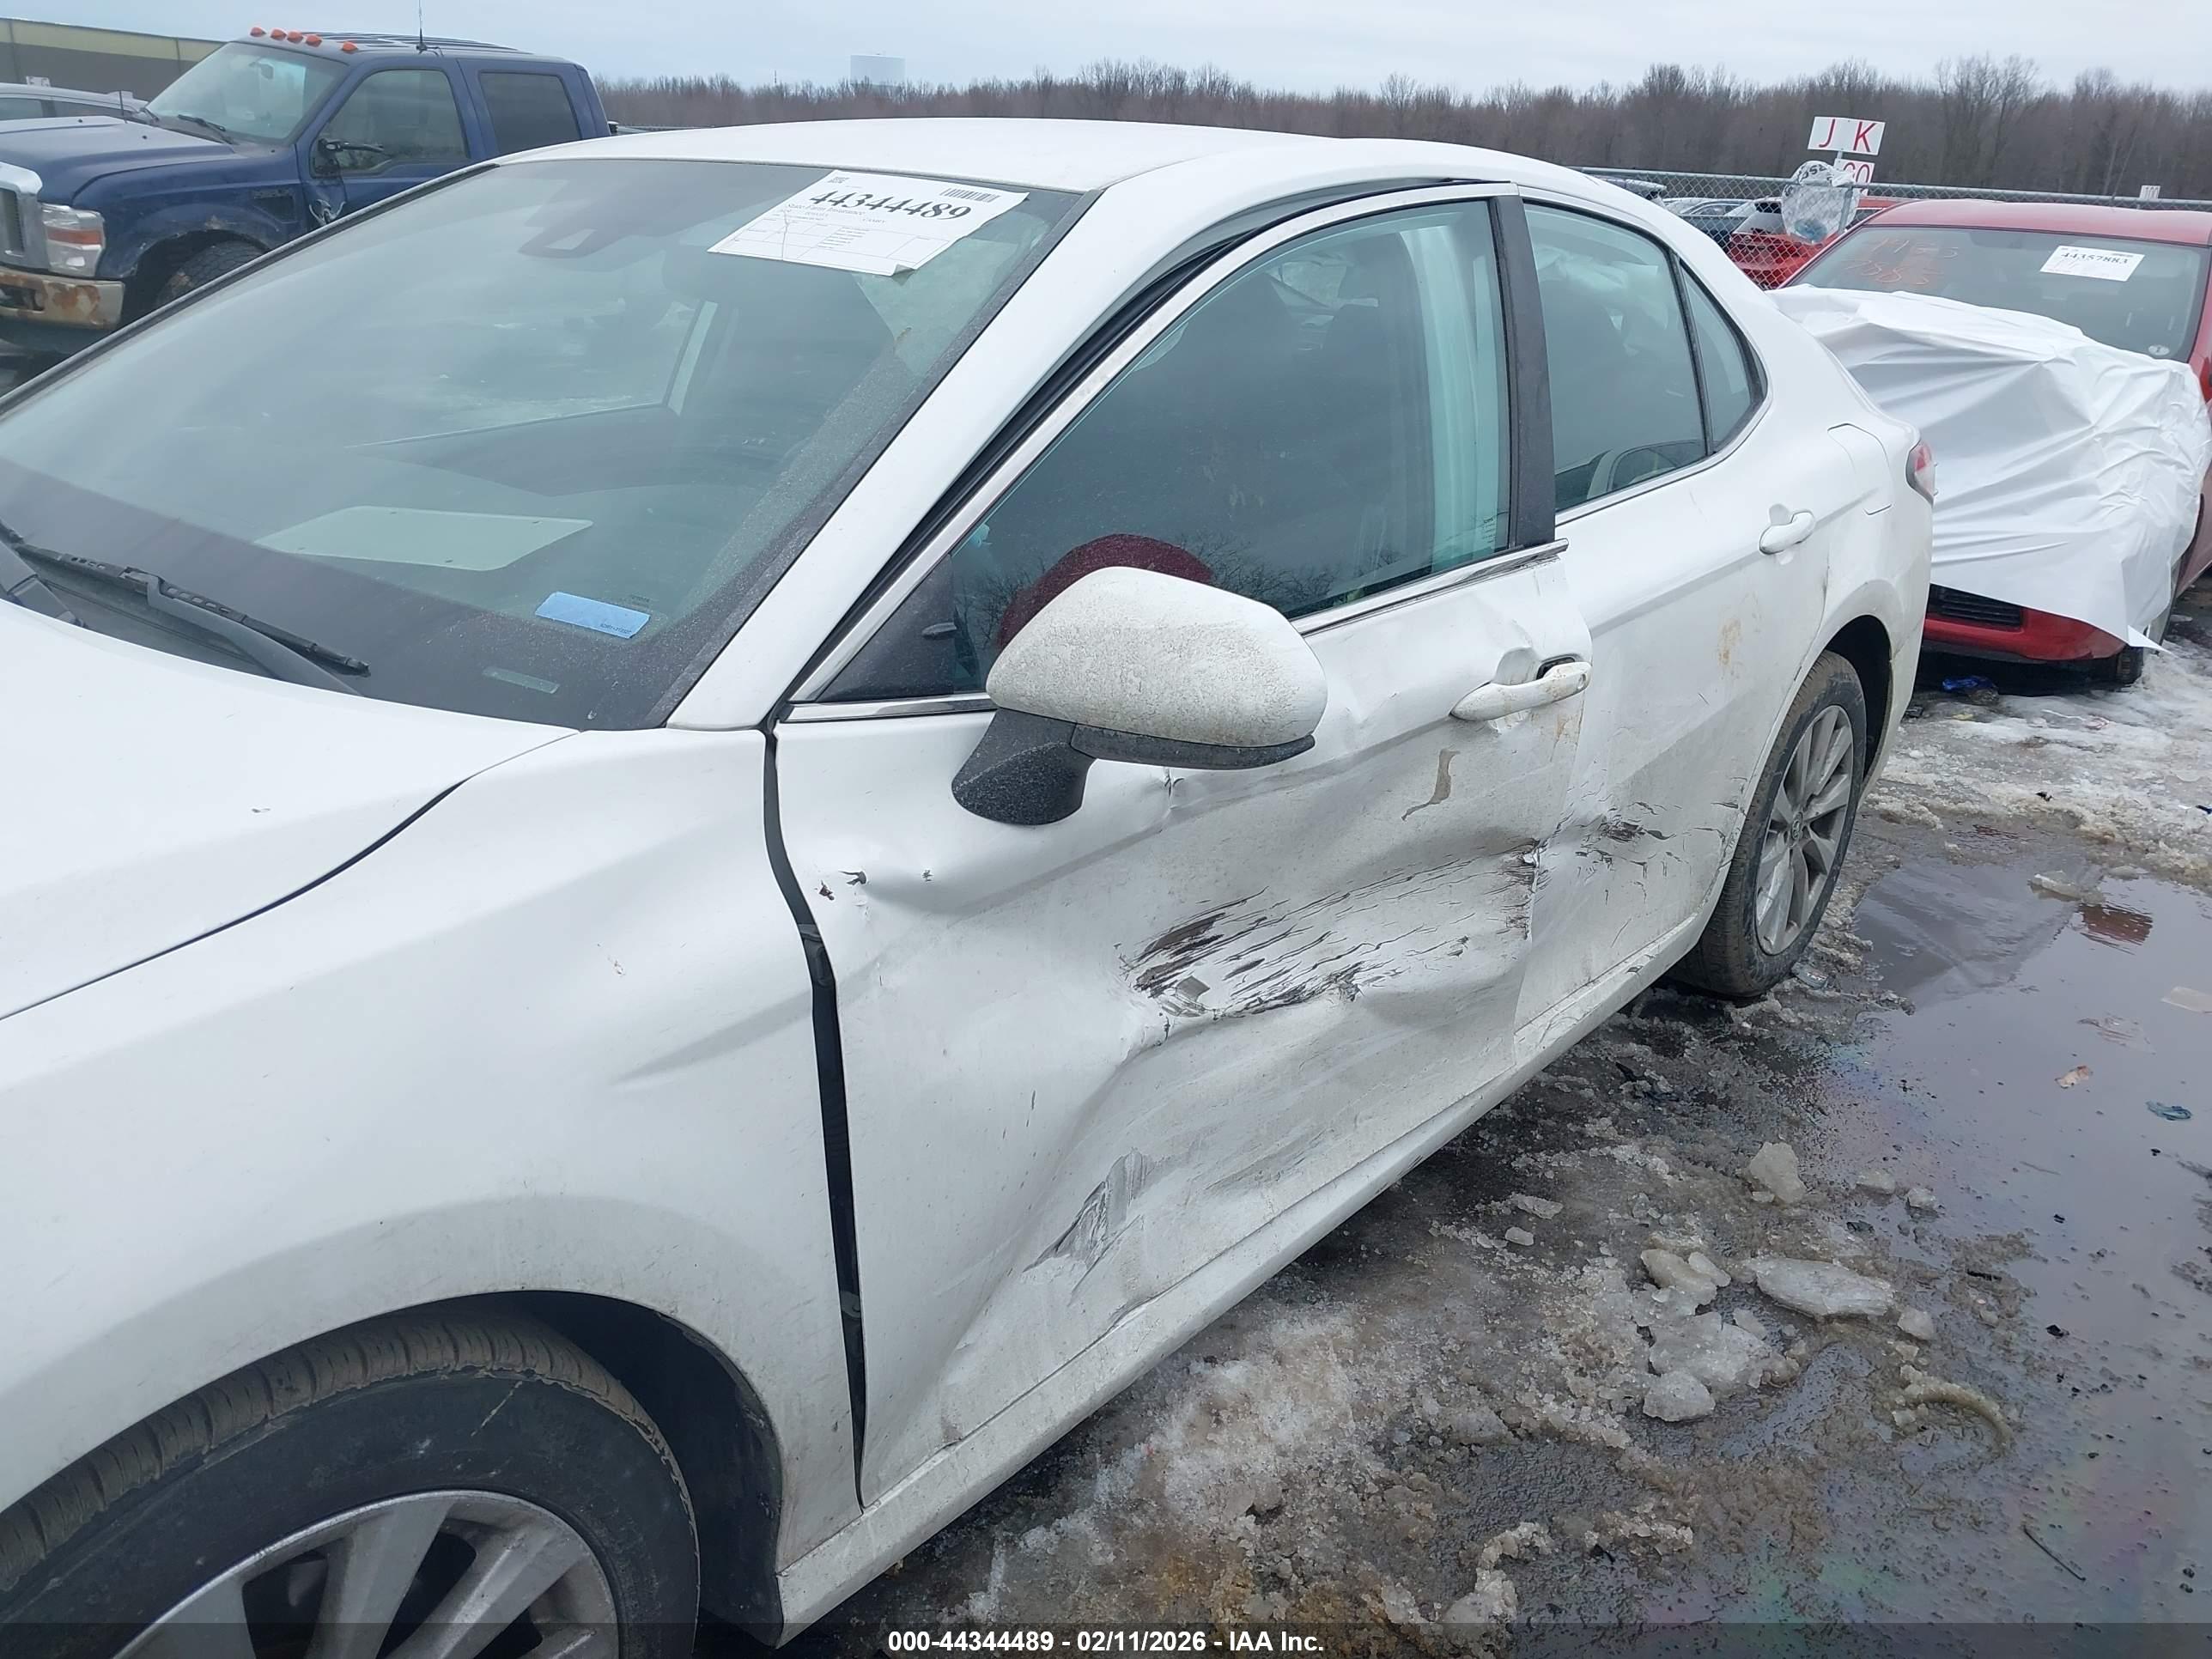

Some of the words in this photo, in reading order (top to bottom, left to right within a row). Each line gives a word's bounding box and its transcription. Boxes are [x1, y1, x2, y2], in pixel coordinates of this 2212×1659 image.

[1818, 118, 1836, 149] J
[1852, 121, 1876, 153] K
[809, 190, 972, 221] 44344489
